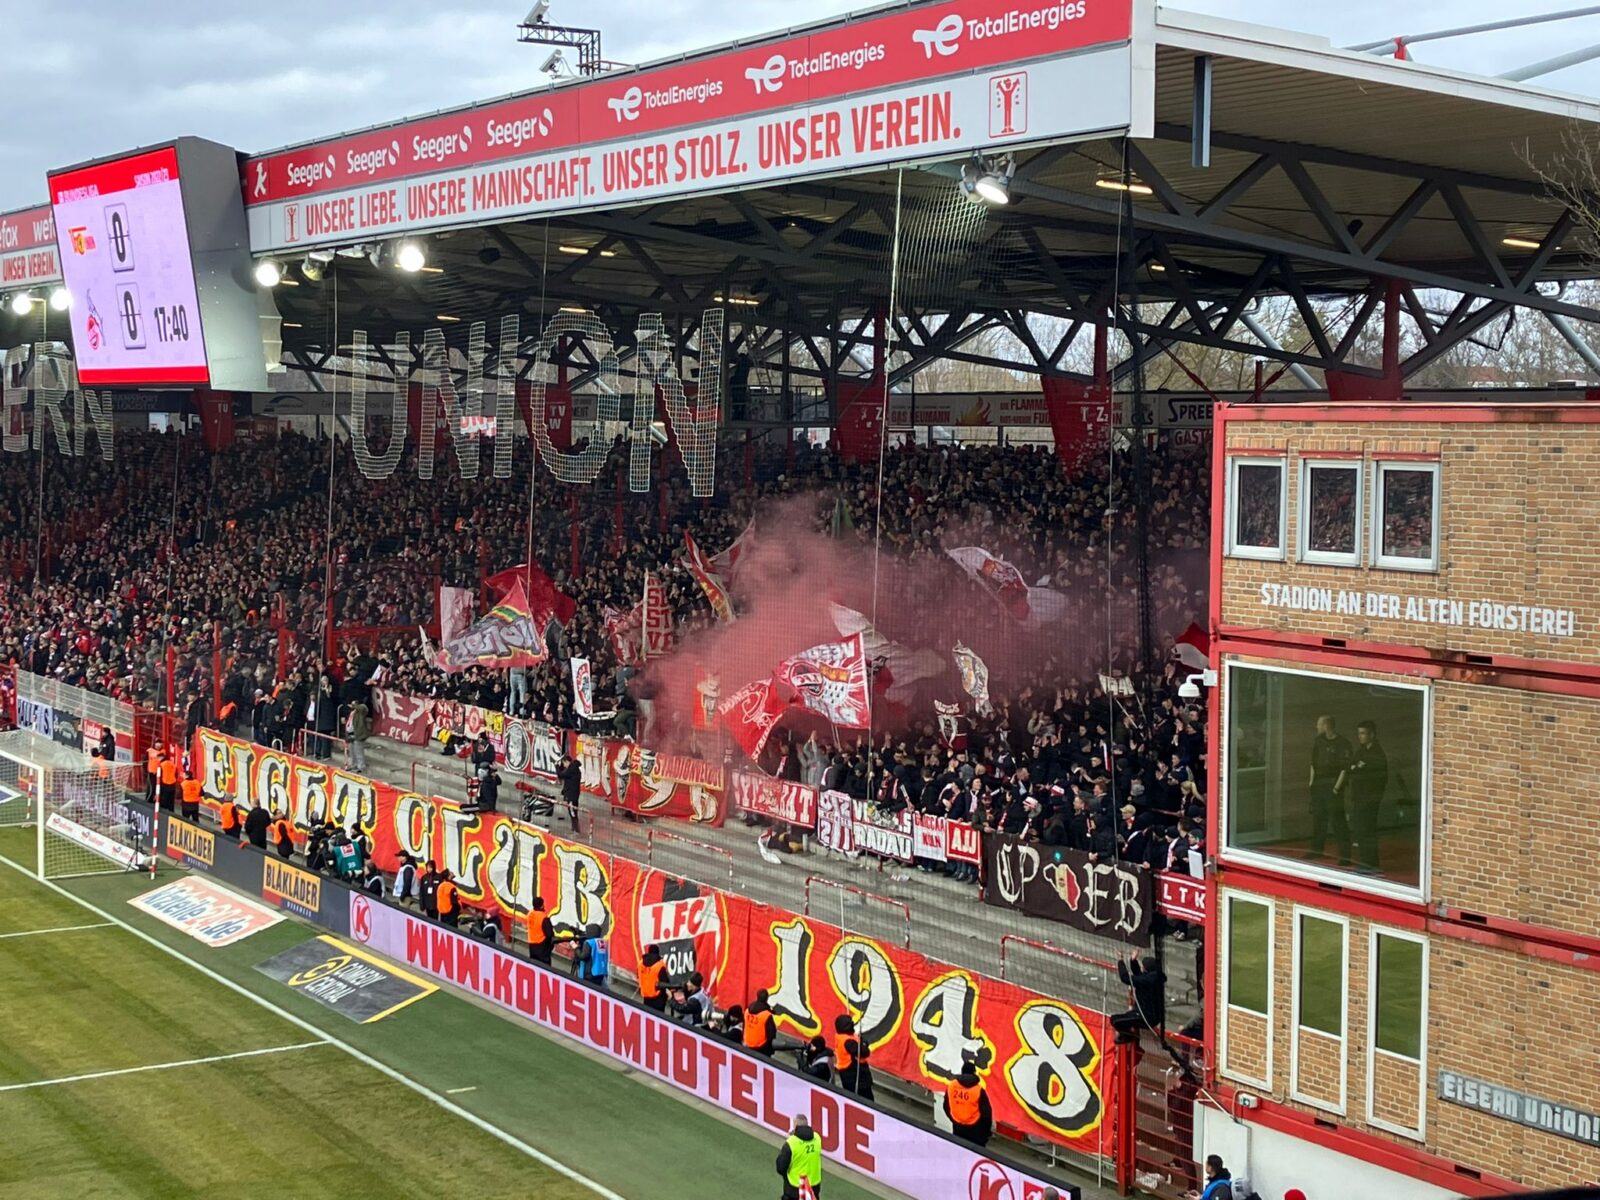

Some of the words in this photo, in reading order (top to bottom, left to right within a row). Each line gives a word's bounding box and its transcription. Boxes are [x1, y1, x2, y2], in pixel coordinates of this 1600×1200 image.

[967, 1, 1086, 40] TotalEnergies
[788, 43, 885, 80] TotalEnergies
[644, 78, 723, 109] TotalEnergies
[412, 132, 458, 162] Seeger
[487, 116, 538, 146] Seeger
[287, 160, 325, 187] Seeger
[306, 197, 355, 236] UNSERE
[360, 189, 401, 228] LIEBE.
[408, 178, 466, 220] UNSERE
[472, 156, 595, 210] MANNSCHAFT.
[603, 143, 668, 192] UNSER
[675, 130, 747, 182] STOLZ.
[758, 111, 841, 169] UNSER
[851, 91, 961, 154] VEREIN.
[347, 146, 389, 175] Seeger
[0, 220, 18, 248] fox
[33, 210, 56, 242] wef
[112, 211, 126, 263] 0
[3, 256, 26, 281] UNSER
[28, 251, 56, 277] VEREIN.
[123, 290, 138, 341] 0
[154, 304, 189, 342] 17:40
[351, 308, 724, 497] UNION
[1260, 583, 1332, 613] STADION
[1336, 590, 1362, 616] AN
[1366, 592, 1400, 619] DER
[1404, 597, 1463, 626] ALTEN
[1469, 598, 1575, 637] FÖRSTEREI
[854, 824, 912, 860] RADAU
[397, 794, 612, 938] CLUB
[265, 862, 319, 908] BLÅKLÄDER
[304, 976, 357, 1004] CENTRAL
[333, 962, 388, 989] COMEDY
[767, 916, 1104, 1138] 1948
[406, 918, 875, 1174] WWW.KONSUMHOTELDE
[952, 1088, 970, 1102] 246
[805, 1143, 815, 1154] 22
